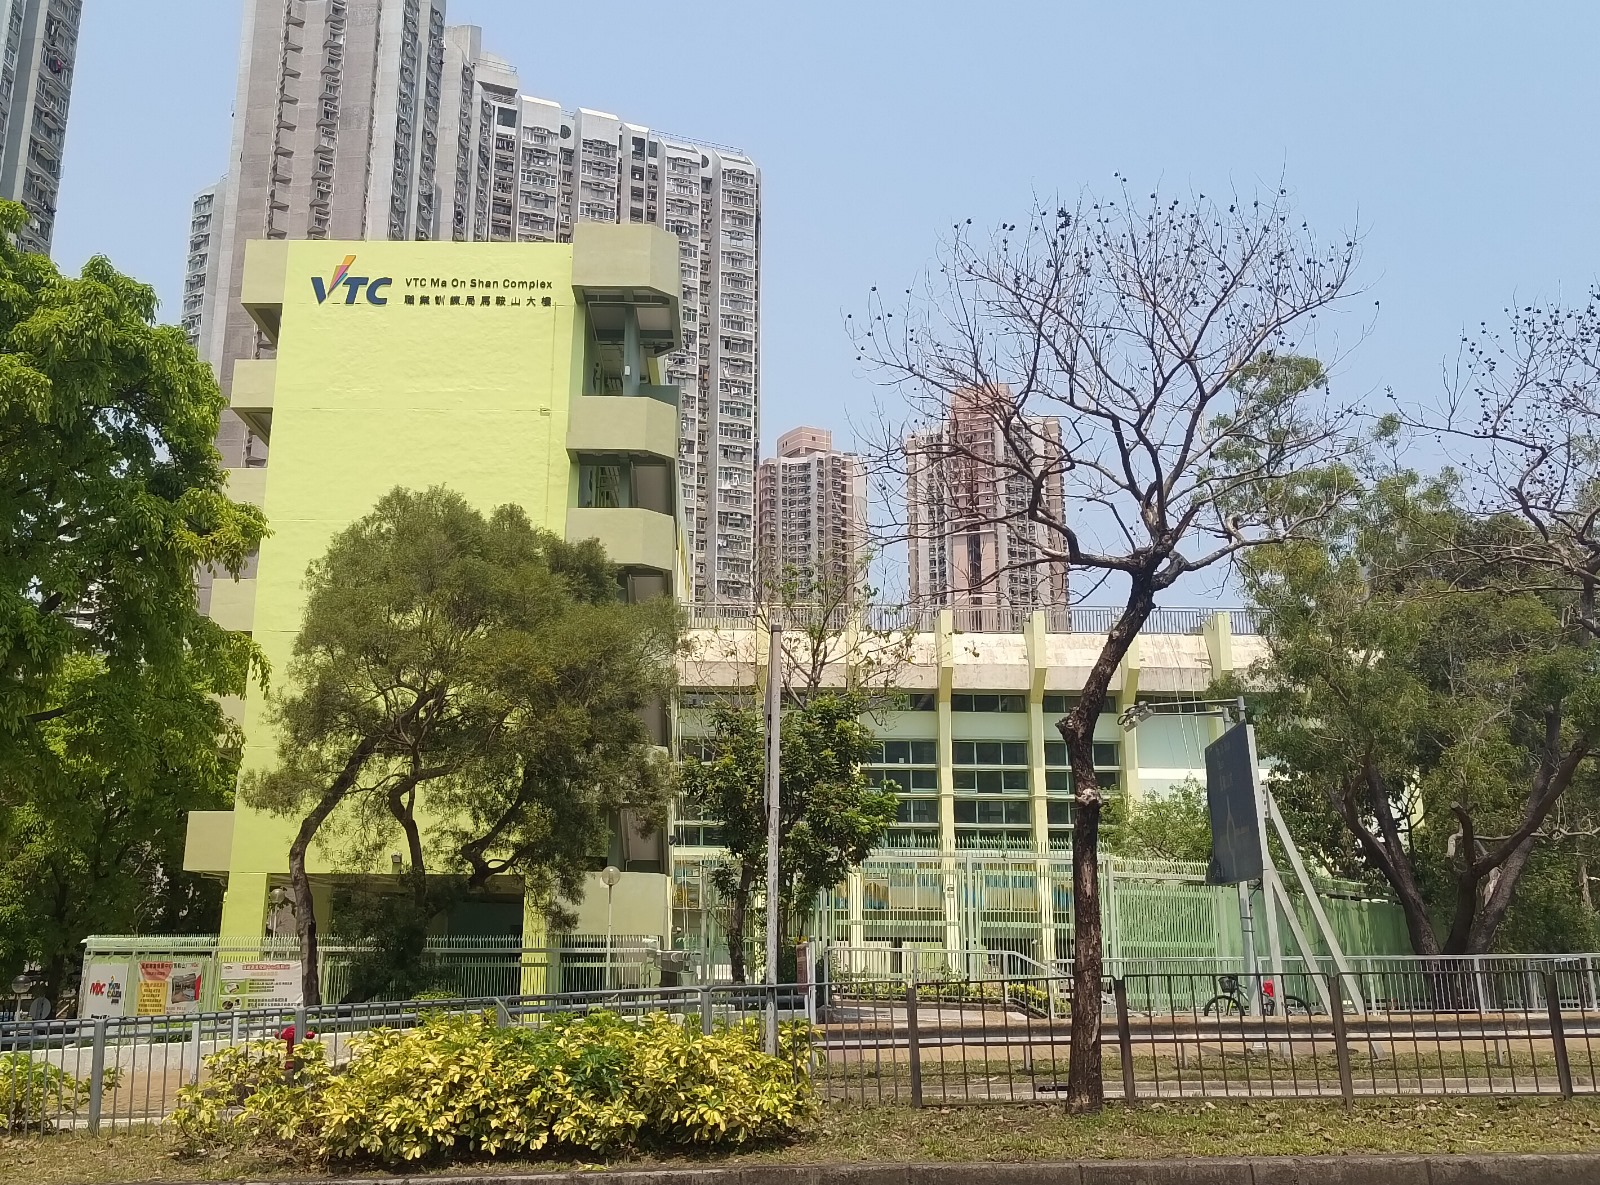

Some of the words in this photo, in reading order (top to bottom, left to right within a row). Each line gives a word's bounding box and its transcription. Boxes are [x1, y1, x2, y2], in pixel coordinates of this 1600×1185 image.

[311, 255, 393, 305] VTC
[405, 278, 427, 288] VTC
[430, 278, 447, 288] Ma
[451, 278, 466, 288] On
[469, 279, 499, 288] Shan
[502, 279, 553, 291] Complex
